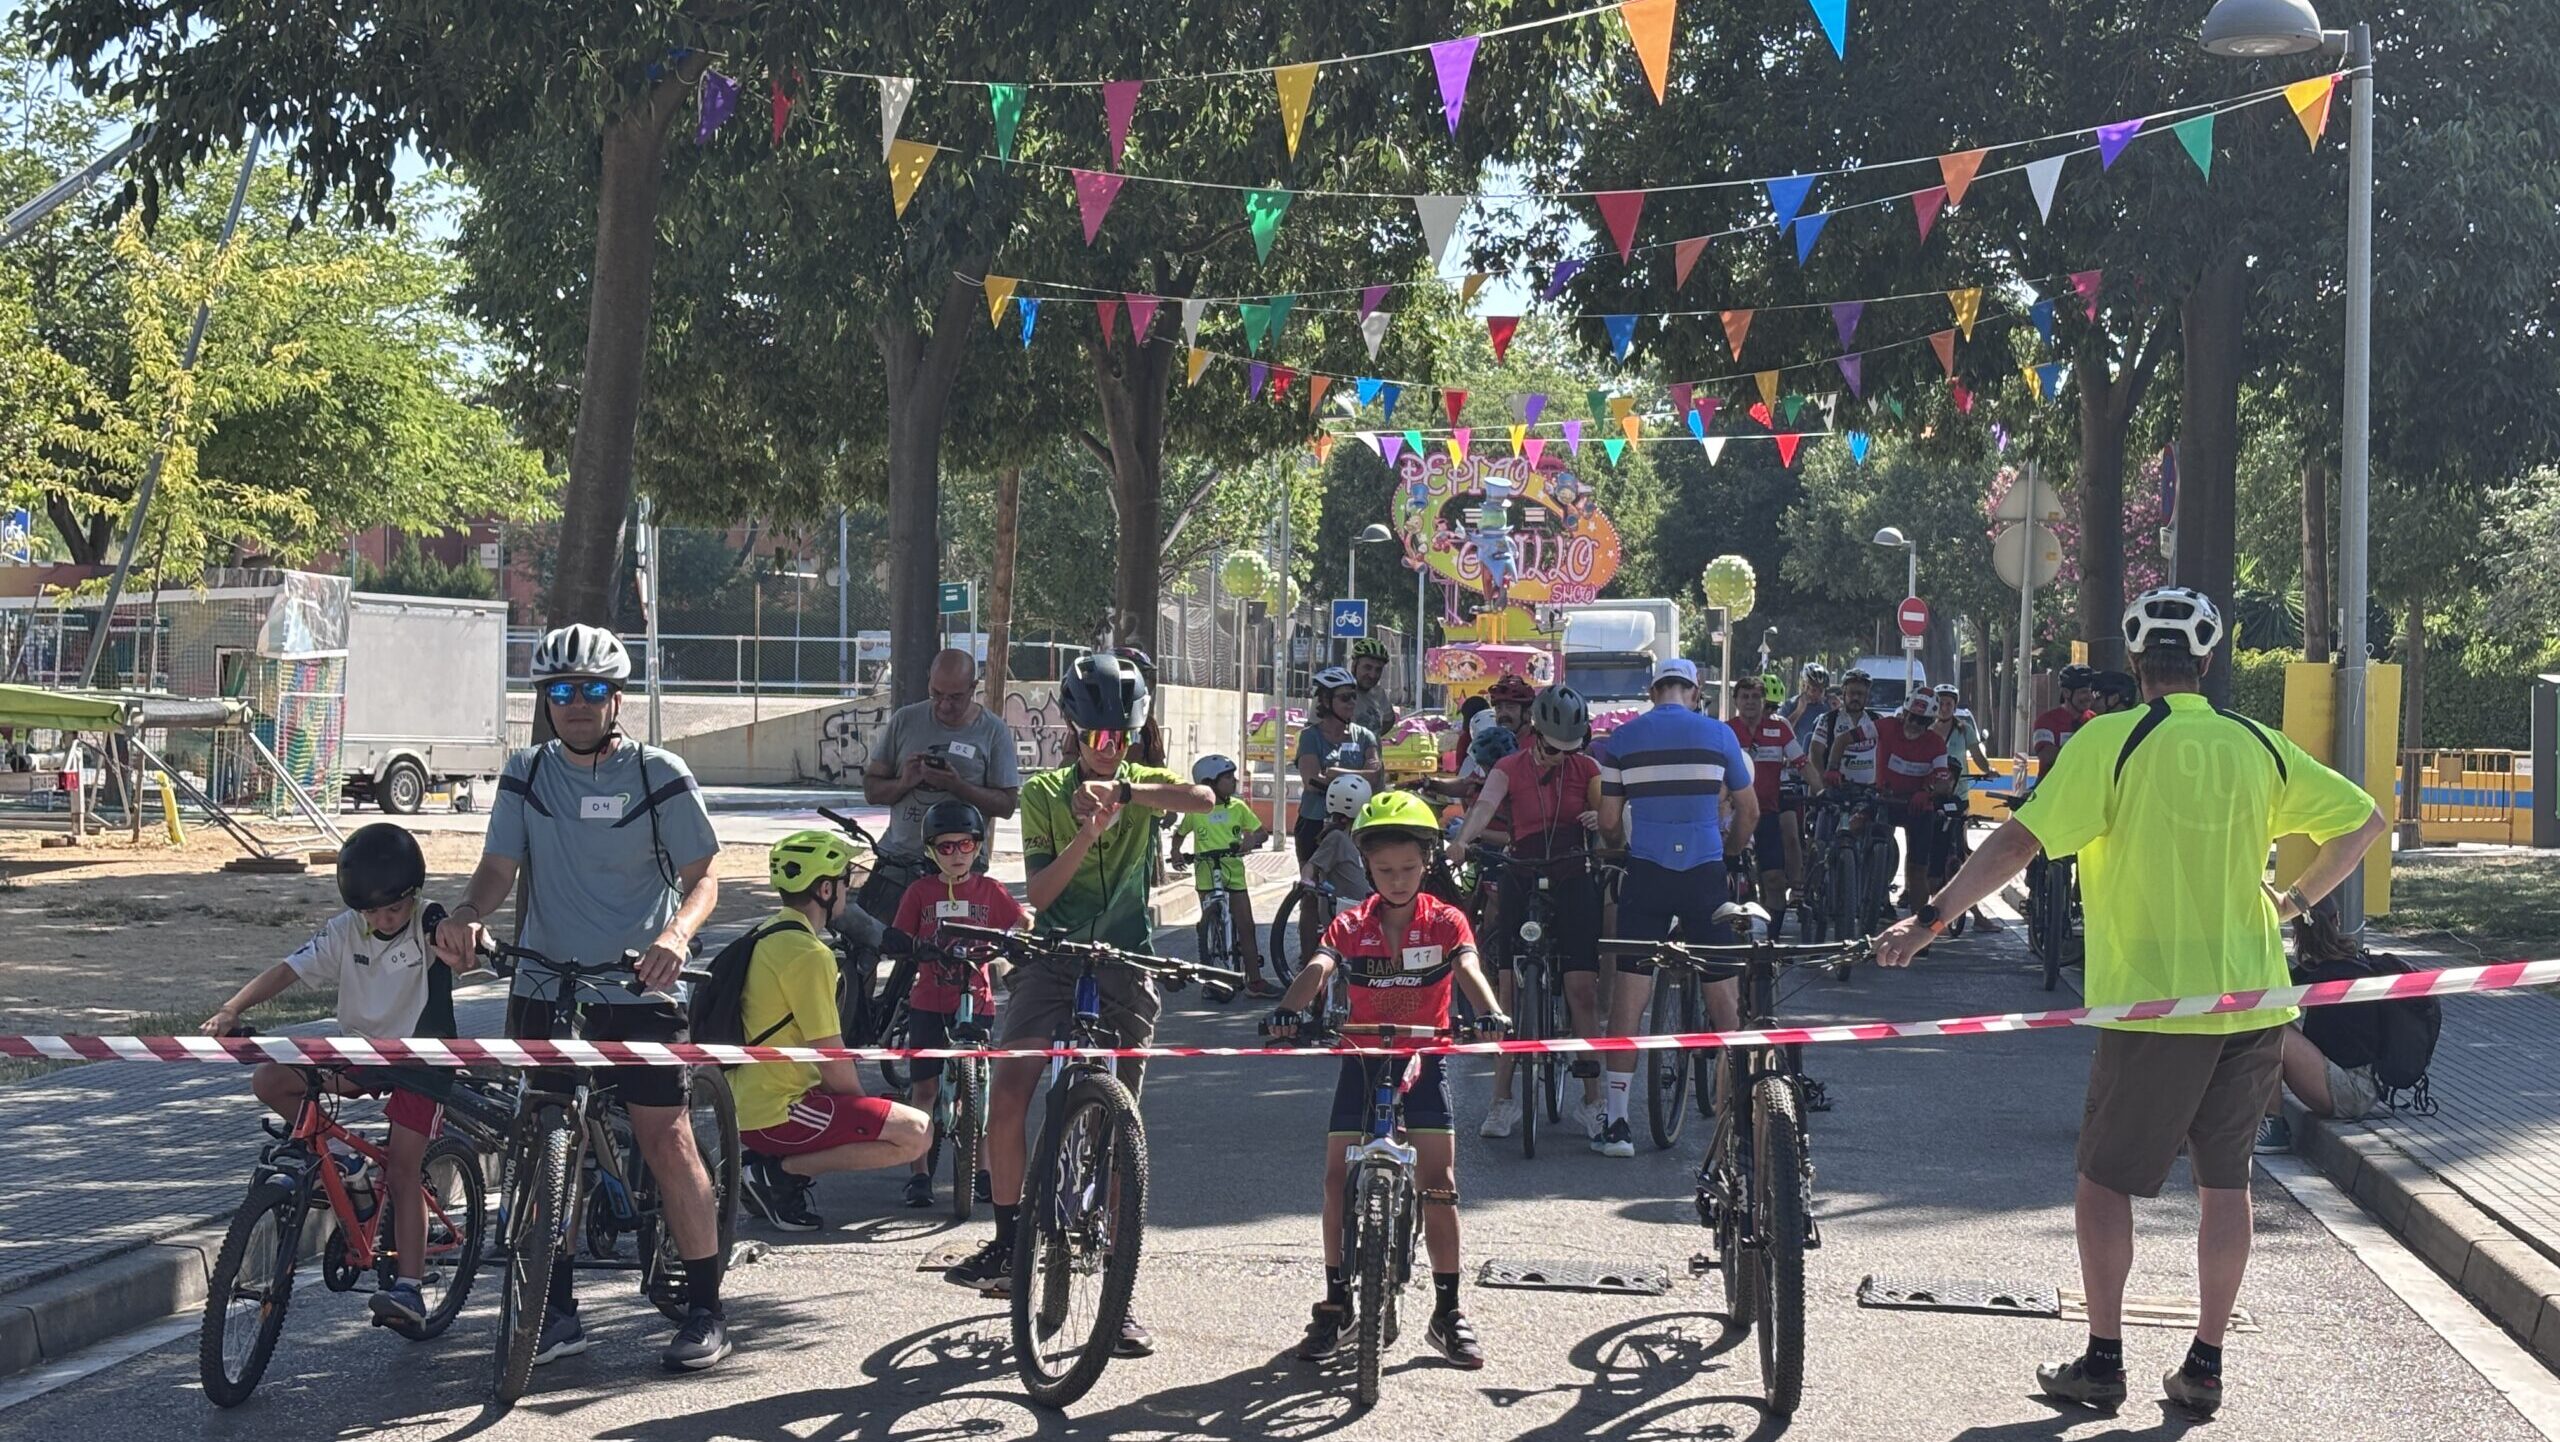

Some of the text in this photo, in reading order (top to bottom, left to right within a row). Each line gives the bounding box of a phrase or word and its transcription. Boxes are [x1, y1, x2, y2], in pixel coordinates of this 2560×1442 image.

[1457, 534, 1600, 584] GILLO
[1551, 583, 1597, 604] SHOW
[2177, 738, 2242, 802] 90
[592, 801, 610, 812] 04
[1413, 950, 1432, 964] 17
